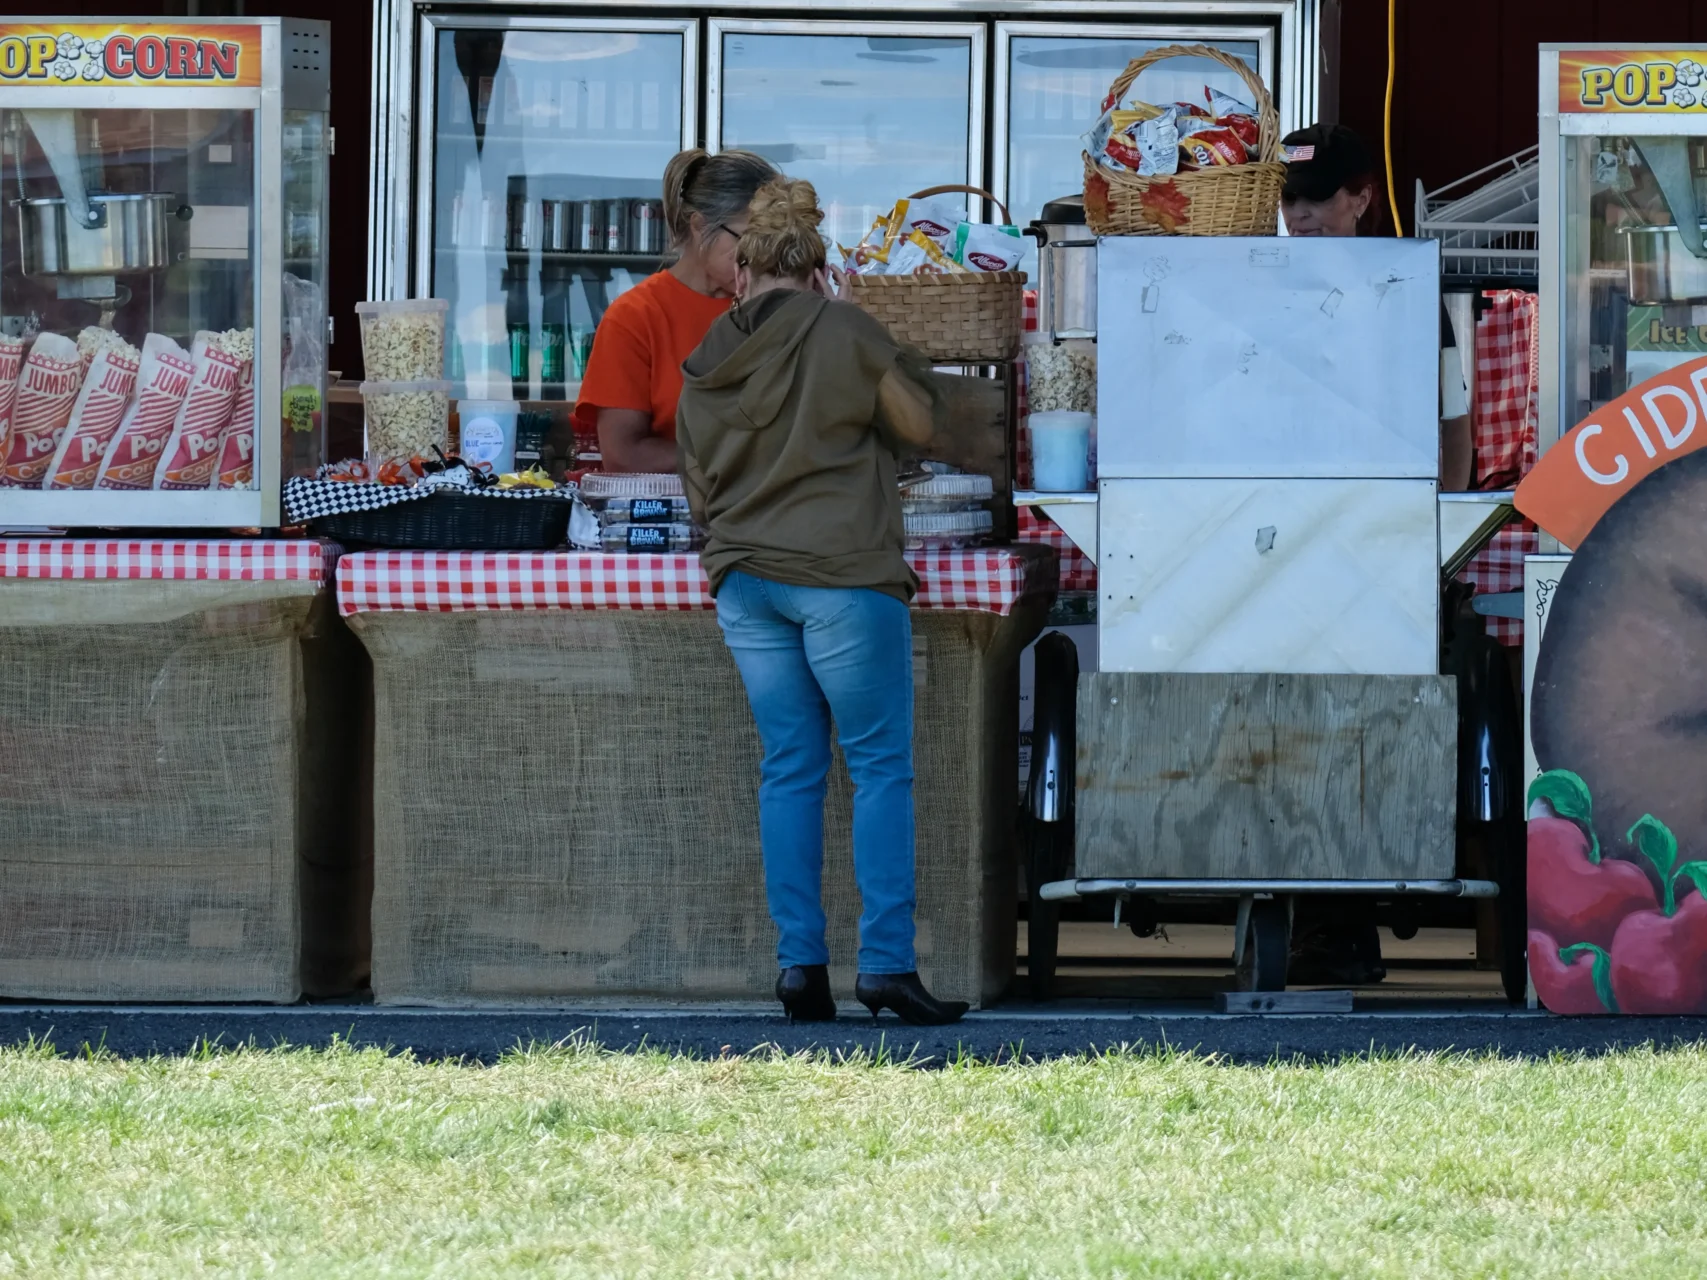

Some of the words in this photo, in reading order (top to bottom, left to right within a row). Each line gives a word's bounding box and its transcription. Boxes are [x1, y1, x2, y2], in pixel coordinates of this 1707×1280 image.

[103, 35, 239, 80] CORN
[1582, 63, 1677, 106] POP
[25, 368, 77, 396] JUMBO
[151, 367, 188, 398] JUM
[202, 362, 239, 392] JUM
[18, 463, 50, 479] Co
[635, 500, 663, 510] KILLER
[632, 528, 660, 538] KILLER
